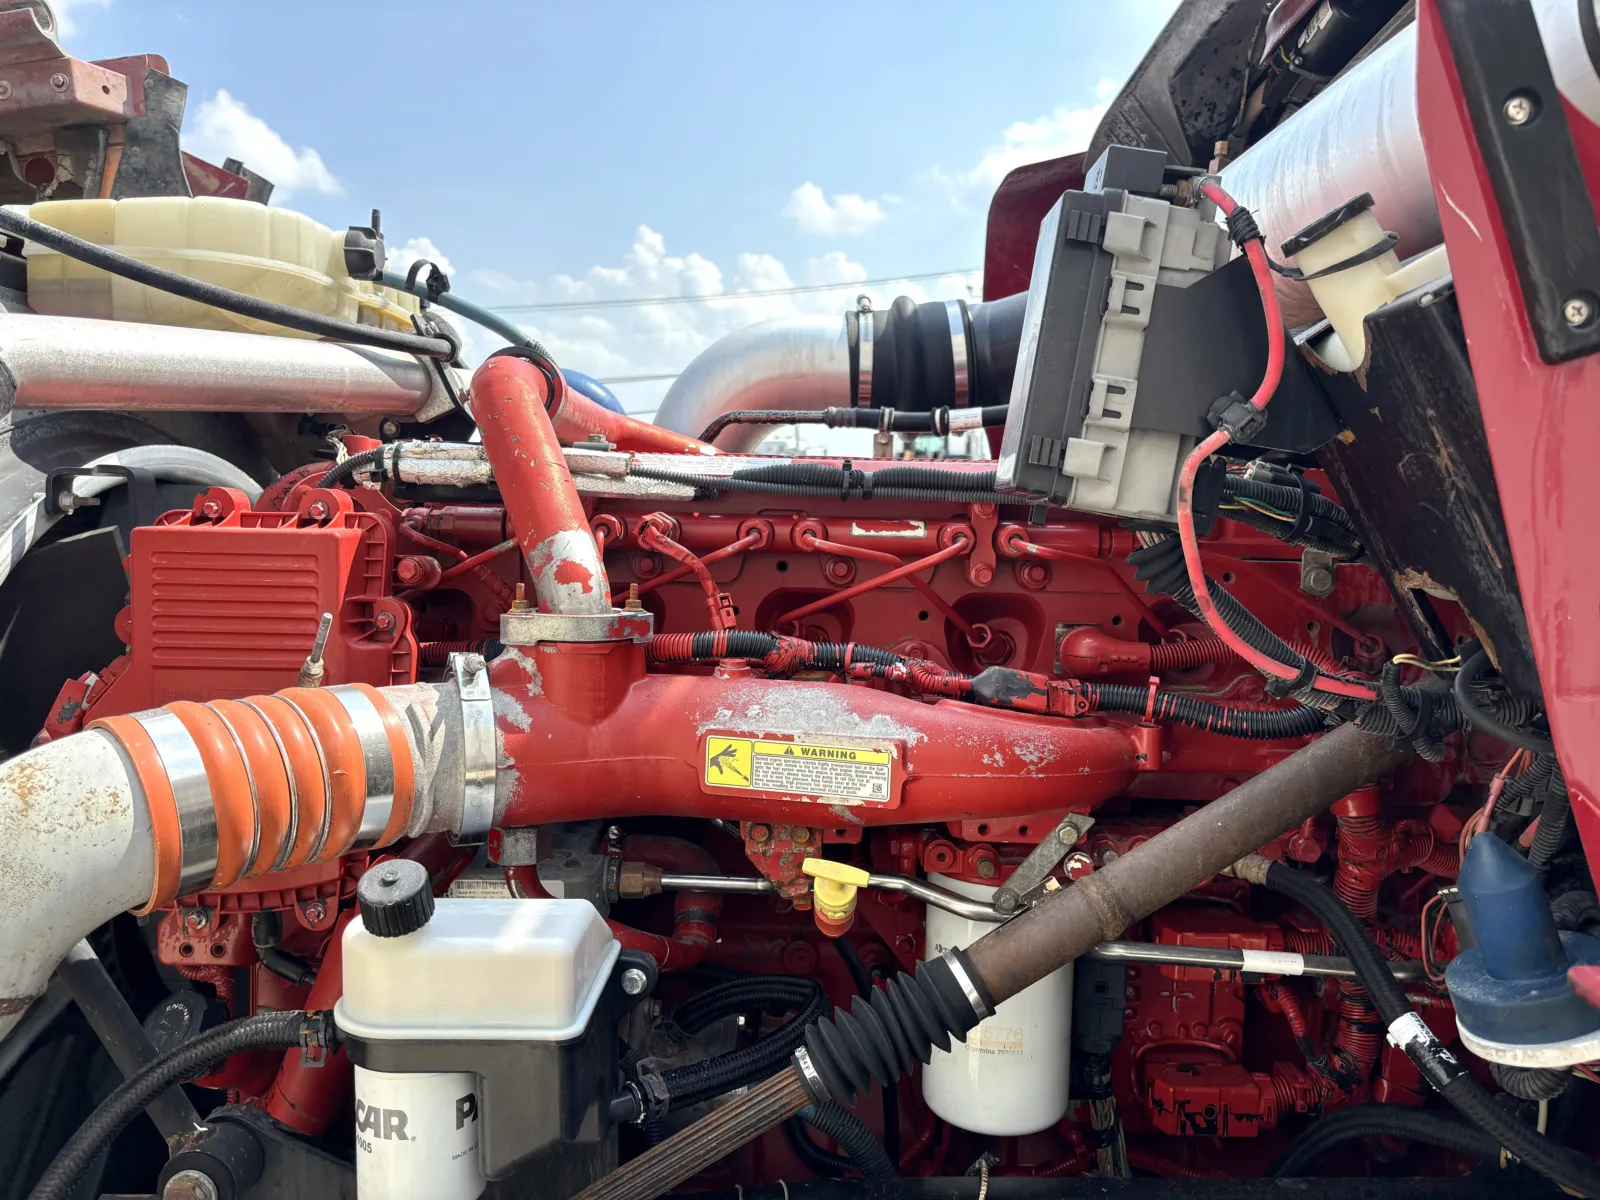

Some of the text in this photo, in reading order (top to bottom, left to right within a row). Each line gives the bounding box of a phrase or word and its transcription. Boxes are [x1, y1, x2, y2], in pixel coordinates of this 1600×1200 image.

[801, 748, 856, 759] WARNING
[166, 1003, 189, 1021] ENGINE
[452, 1149, 467, 1160] MADE
